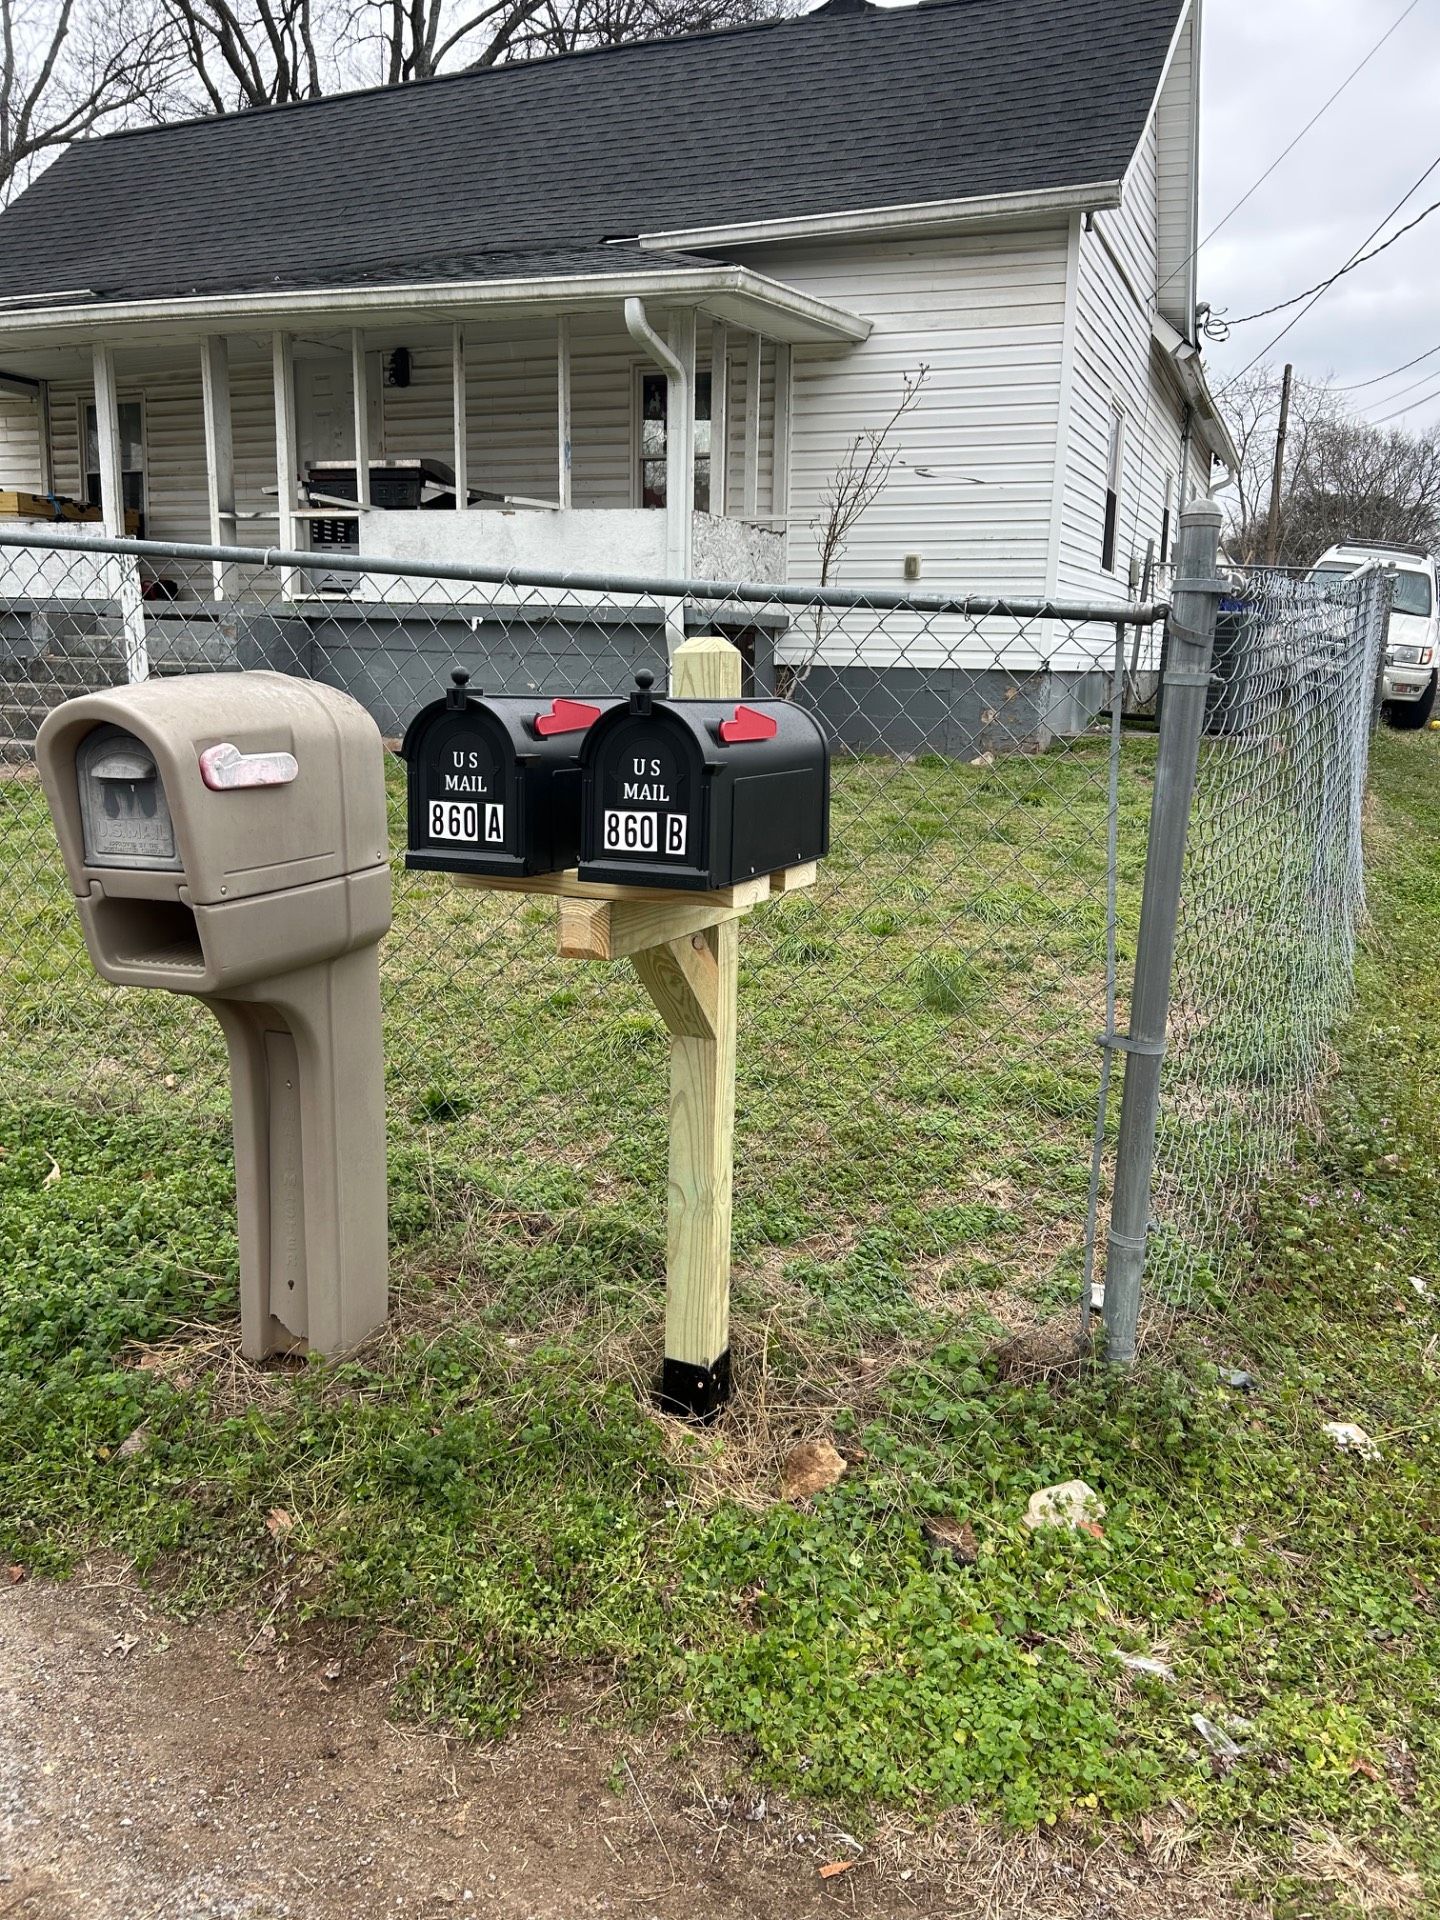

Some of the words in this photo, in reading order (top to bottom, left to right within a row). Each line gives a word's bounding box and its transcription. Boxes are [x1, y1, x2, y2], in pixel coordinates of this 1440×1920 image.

[444, 774, 487, 793] MAIL
[623, 782, 670, 802] MAIL
[432, 803, 476, 837] 860
[488, 806, 502, 840] A
[607, 813, 654, 849] 860
[669, 817, 684, 852] B
